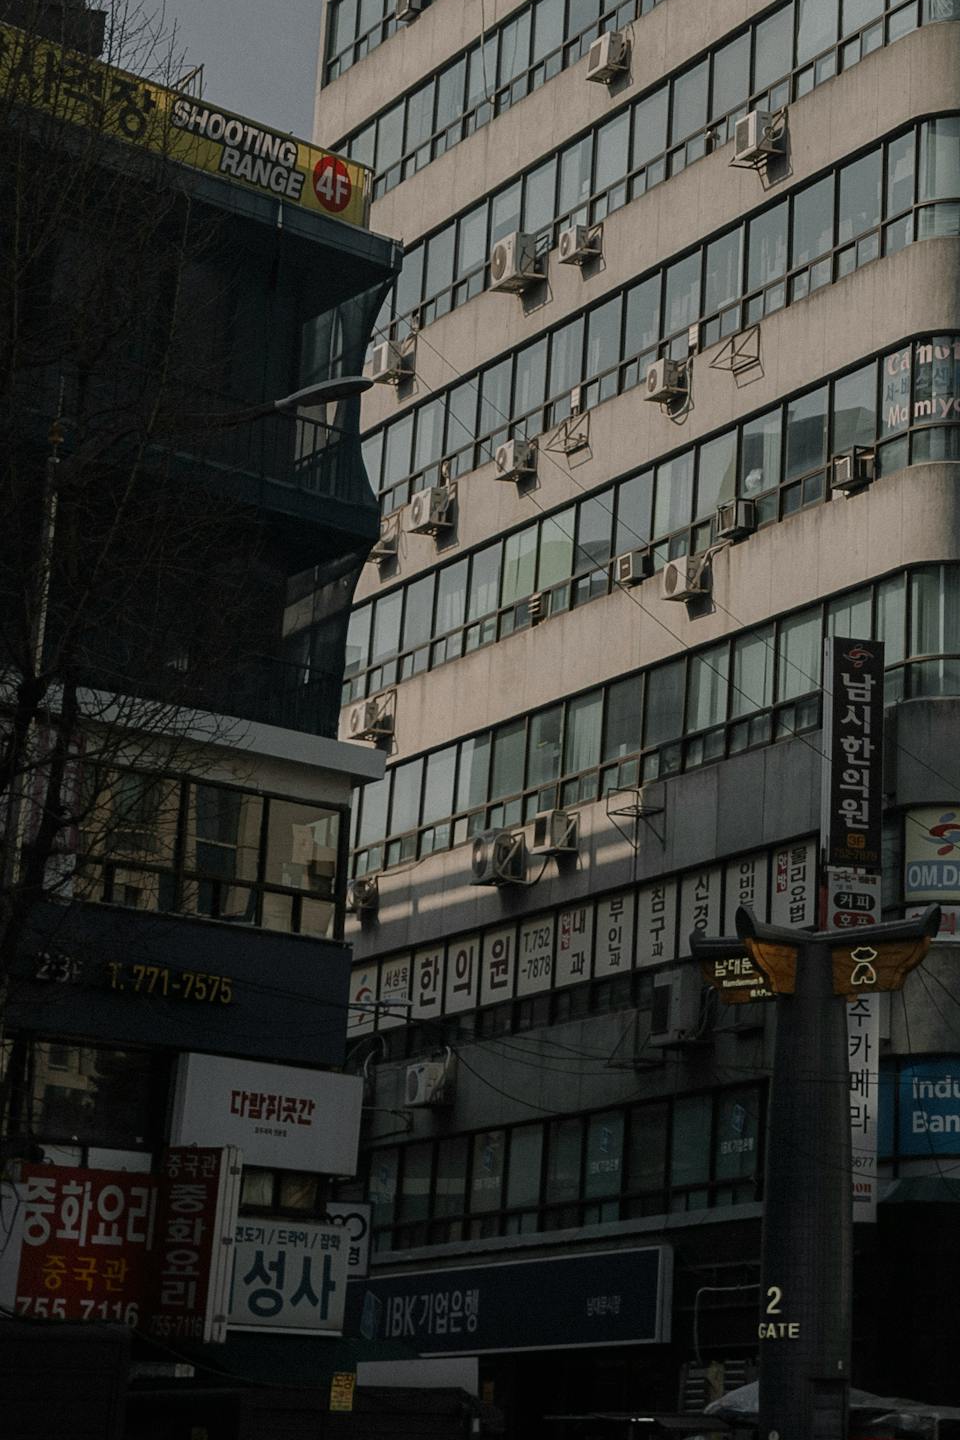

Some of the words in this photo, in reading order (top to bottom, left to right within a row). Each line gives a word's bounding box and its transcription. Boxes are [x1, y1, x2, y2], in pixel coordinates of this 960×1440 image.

[171, 97, 299, 169] SHOOTING
[219, 146, 306, 200] RANGE
[315, 165, 350, 207] 4F
[838, 671, 877, 831] 남시한의원
[693, 872, 711, 937] 신경
[739, 860, 756, 910] 이비인
[840, 893, 870, 910] 커피
[523, 926, 551, 953] T.752
[570, 908, 587, 976] 내과
[608, 897, 625, 967] 부인과
[649, 886, 666, 958] 침구과
[132, 963, 234, 1005] 771-7575
[419, 935, 511, 1008] 한의원
[230, 1089, 316, 1126] 다람쥐곳간
[166, 1153, 218, 1179] 중국관
[24, 1176, 160, 1251] 중화요리
[160, 1183, 208, 1310] 중화요리
[277, 1229, 309, 1248] 드라이
[320, 1233, 341, 1251] 잡화
[42, 1254, 129, 1292] 중국관
[229, 1247, 337, 1322] 성사
[16, 1295, 66, 1320] 755
[80, 1298, 140, 1329] 7116
[765, 1284, 783, 1315] 2
[757, 1322, 801, 1340] GATE
